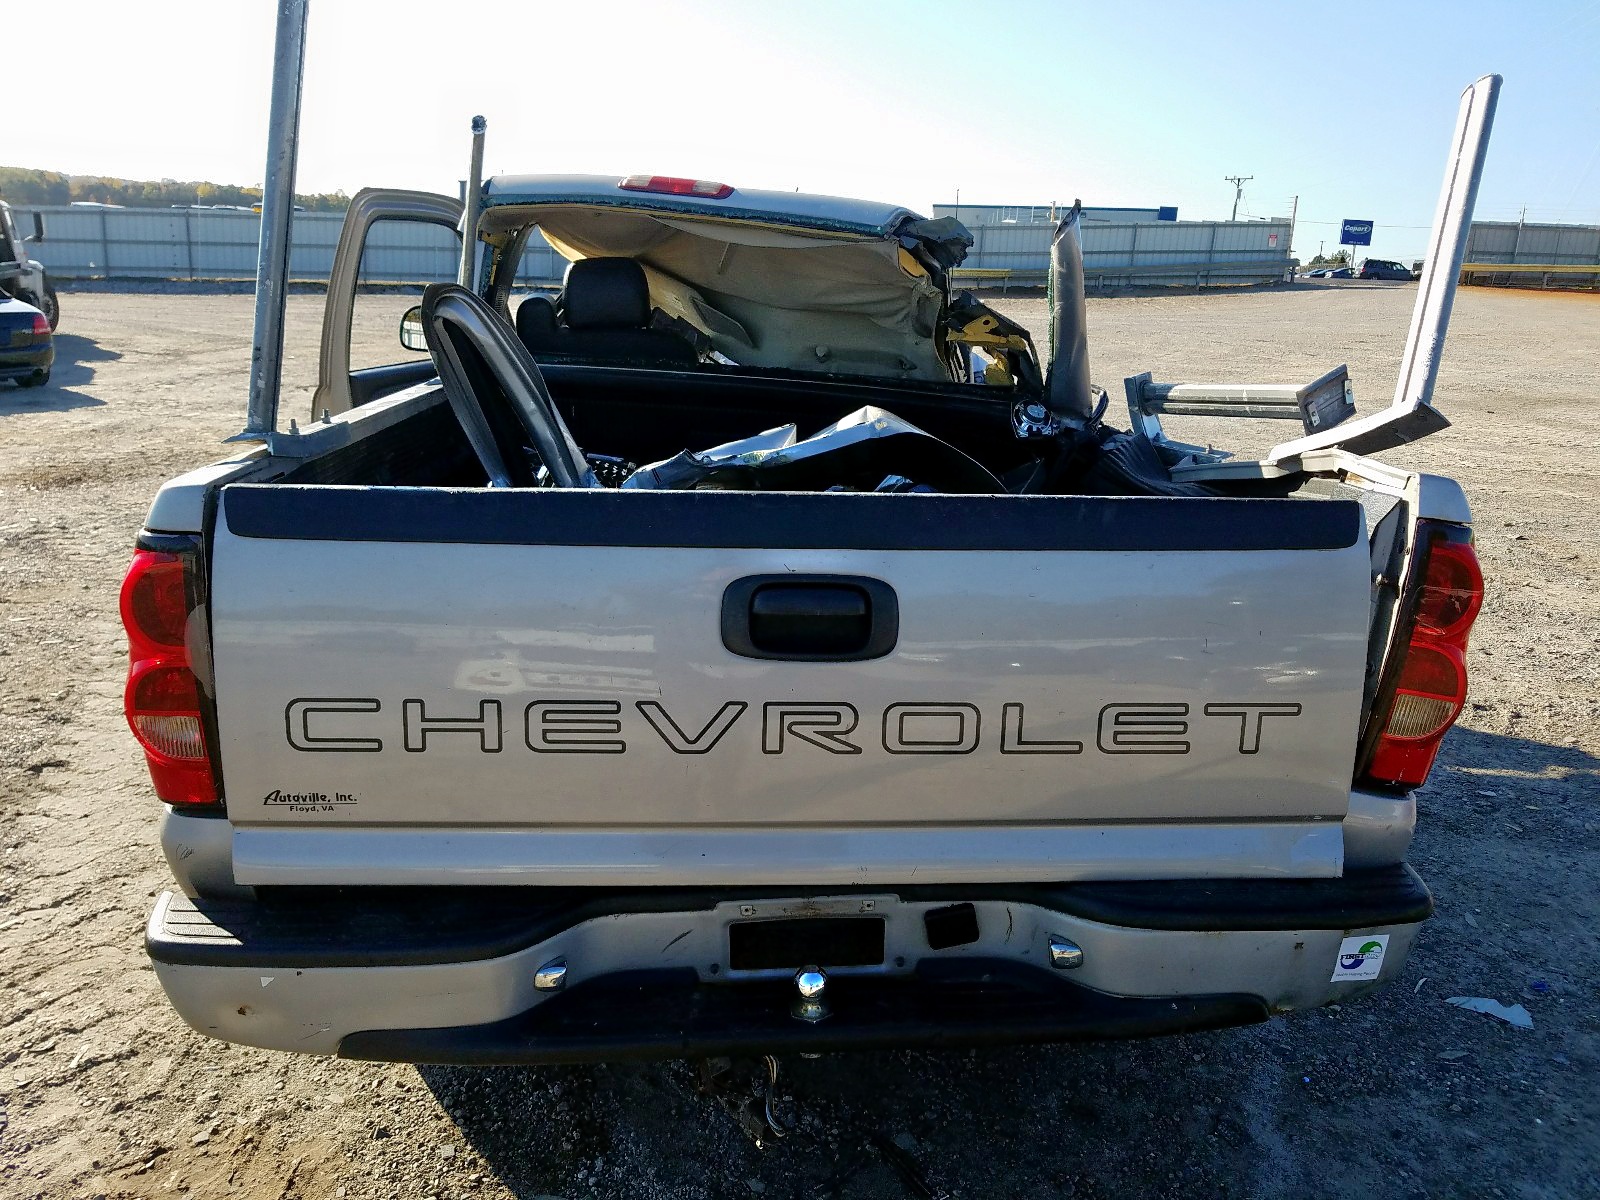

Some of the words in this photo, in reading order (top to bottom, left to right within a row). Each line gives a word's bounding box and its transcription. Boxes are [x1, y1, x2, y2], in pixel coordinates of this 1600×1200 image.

[285, 698, 1302, 756] CHEVROLET
[335, 792, 358, 802] Inc.
[289, 805, 320, 813] Floyd,
